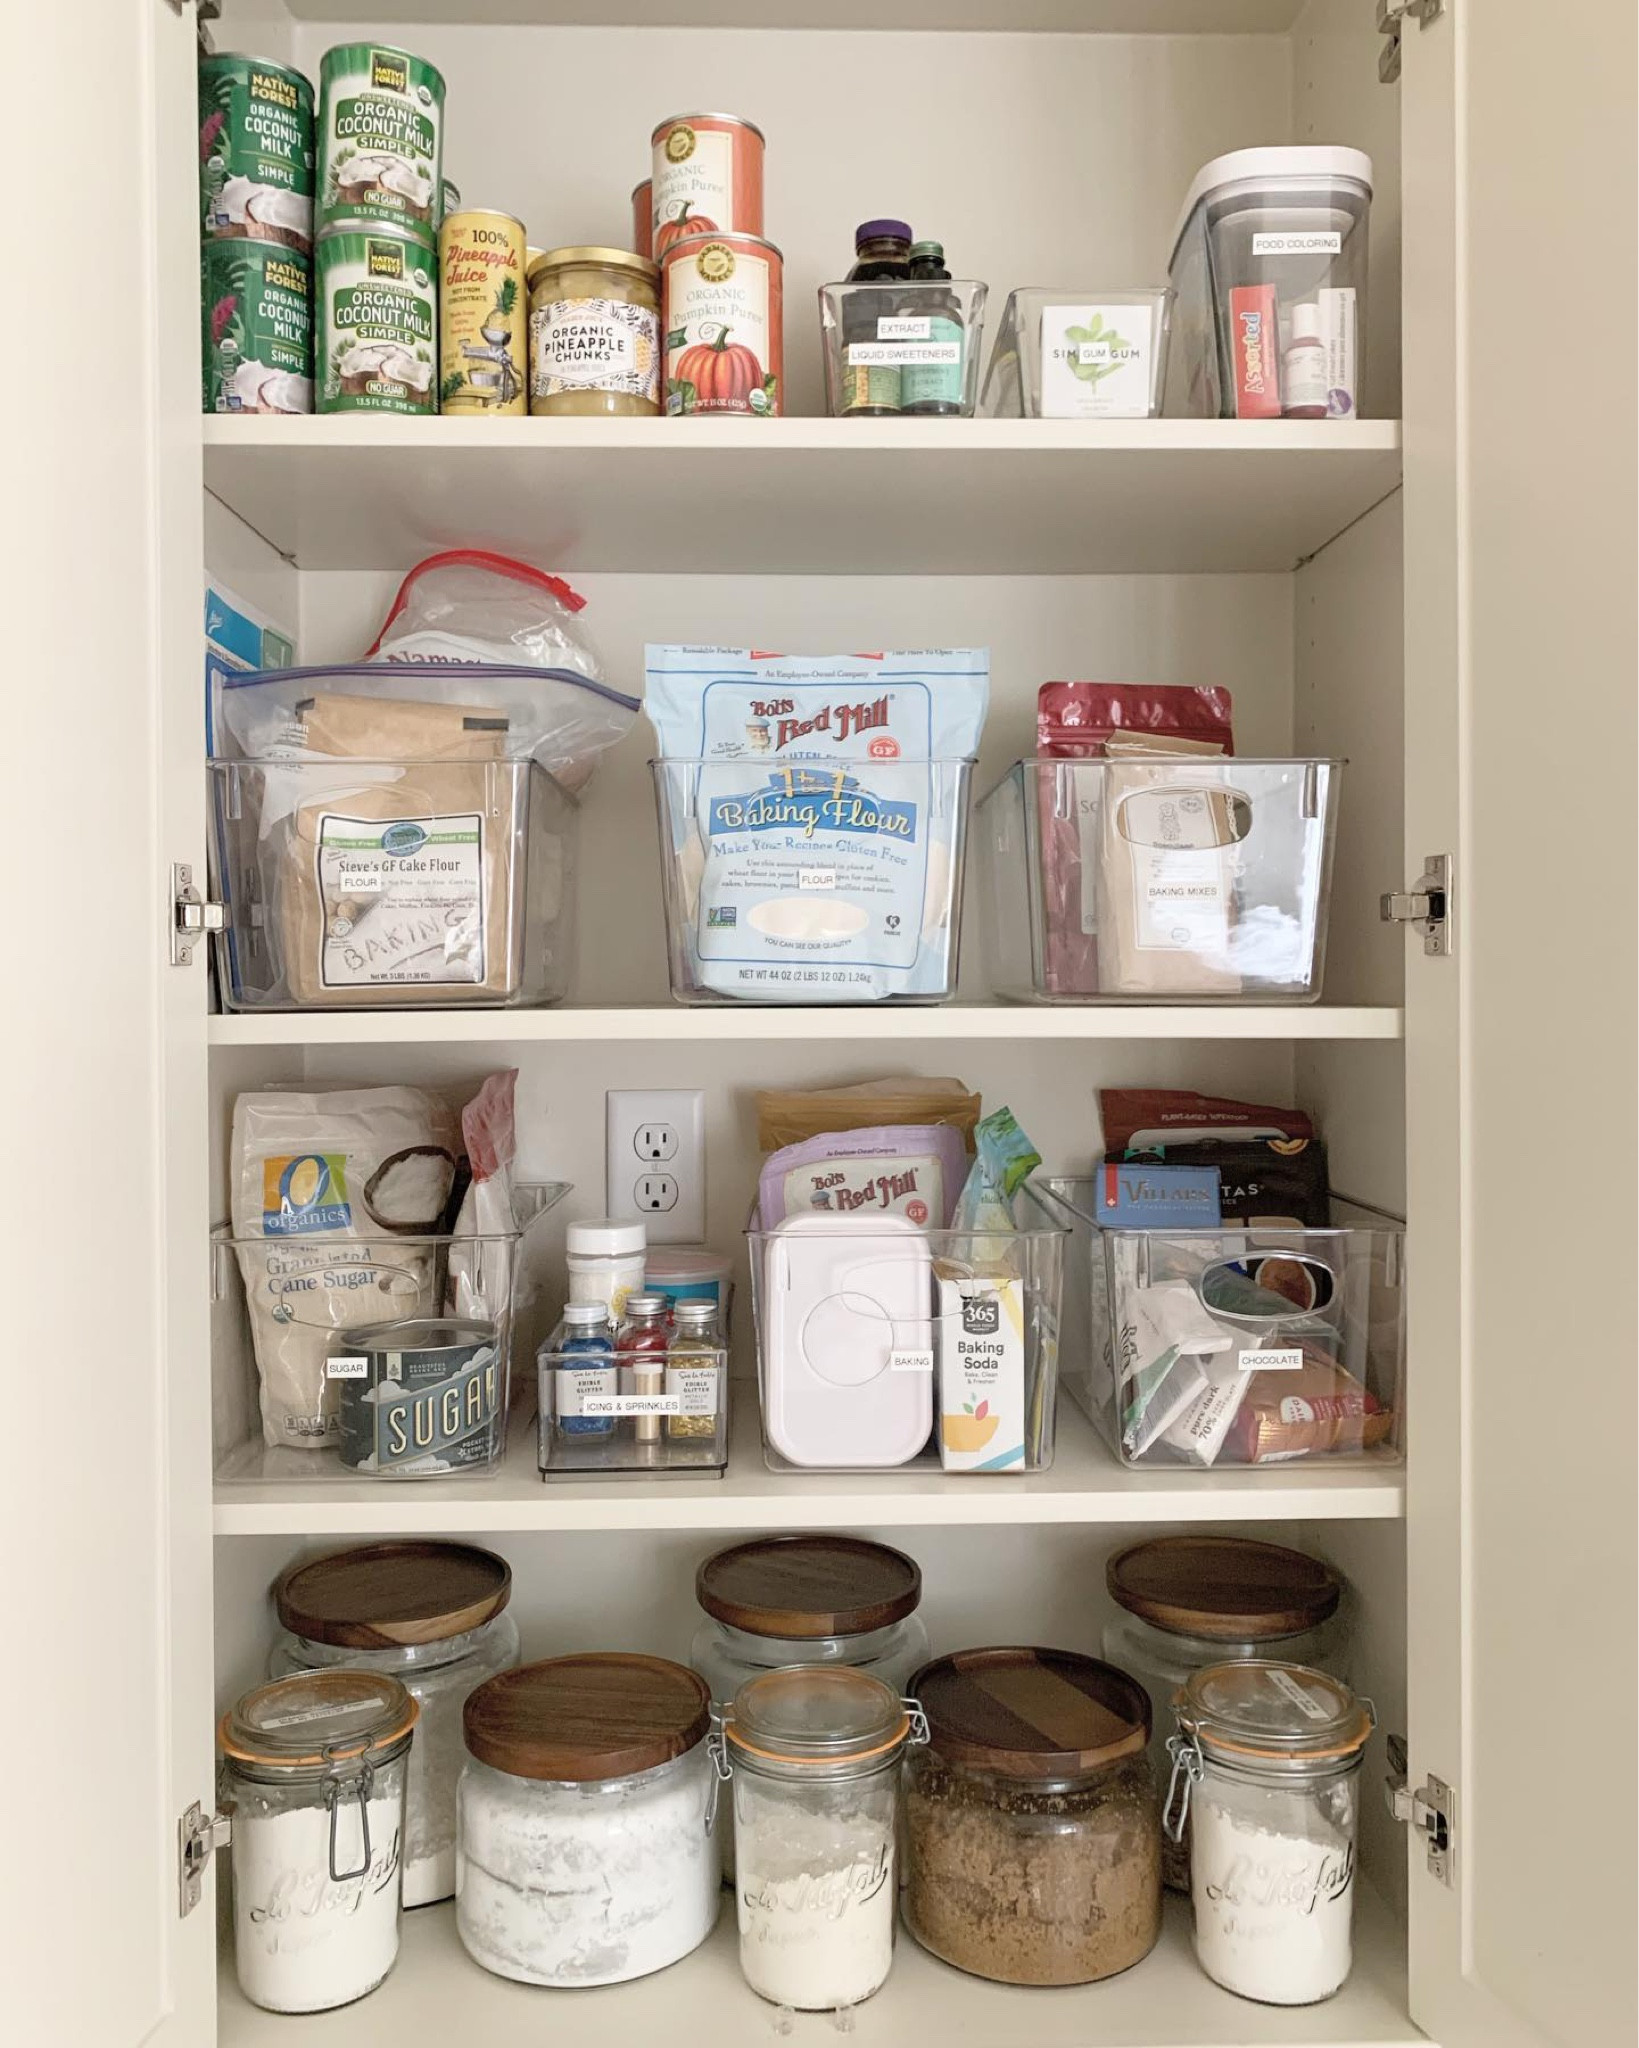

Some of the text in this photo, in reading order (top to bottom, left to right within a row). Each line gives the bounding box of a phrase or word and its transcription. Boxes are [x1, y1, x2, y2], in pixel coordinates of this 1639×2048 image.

[375, 66, 404, 80] NATIVE
[375, 74, 406, 88] FOREST
[252, 74, 297, 97] NATIVE
[251, 86, 297, 109] FOREST
[250, 104, 298, 129] ORGANIC
[354, 101, 420, 130] ORGANIC
[244, 117, 302, 148] COCONUT
[337, 117, 433, 157] COCONUT MILK
[261, 136, 292, 159] MILK
[359, 137, 414, 159] SIMPLE
[257, 164, 295, 185] SIMPLE
[368, 192, 380, 202] NO
[369, 208, 378, 217] FL
[379, 209, 389, 218] OZ
[472, 229, 509, 248] 100%
[1256, 238, 1338, 249] FOOD COLORING
[371, 255, 401, 266] NATIVE
[446, 246, 519, 270] Pineapple
[266, 260, 307, 281] NATIVE
[371, 263, 401, 275] FOREST
[446, 264, 488, 286] Juice
[265, 272, 307, 293] FOREST
[465, 287, 481, 295] FROM
[264, 289, 307, 314] ORGANIC
[352, 291, 418, 314] ORGANIC
[686, 288, 746, 302] ORGANIC
[258, 302, 311, 333] COCONUT
[336, 306, 401, 326] COCONUT
[403, 316, 431, 338] MILK
[673, 304, 764, 326] Pumpkin Puree
[274, 321, 302, 343] MILK
[359, 326, 411, 344] SIMPLE
[552, 326, 614, 339] ORGANIC
[881, 324, 926, 333] EXTRACT
[544, 337, 625, 356] PINEAPPLE
[852, 349, 956, 360] LIQUID SWEETENERS
[1053, 349, 1141, 360] SIM GUM
[1083, 348, 1107, 360] GUM
[1240, 311, 1264, 393] Assorted
[271, 350, 305, 369] SIMPLE
[555, 351, 611, 364] CHUNKS
[369, 383, 405, 397] NO GUAR
[373, 398, 379, 407] FL
[380, 399, 391, 408] OZ
[764, 669, 774, 678] An
[838, 669, 869, 679] Company
[750, 694, 890, 751] Bob's Red Mill
[873, 745, 895, 755] GF
[716, 798, 911, 837] Baking Flour
[713, 843, 748, 857] Make
[836, 839, 878, 858] Gluten
[881, 847, 908, 866] Free
[339, 858, 460, 873] Steve's GF Cake Flour
[344, 879, 378, 887] FLOUR
[802, 875, 833, 884] FLOUR
[1149, 887, 1217, 897] BAKING MIXES
[344, 908, 468, 972] BAKING
[764, 937, 779, 947] YOU
[780, 940, 794, 949] CAN
[795, 941, 807, 950] SEE
[808, 941, 822, 950] OUR
[739, 969, 754, 980] NET
[756, 970, 767, 980] WT
[769, 970, 780, 980] 44
[781, 970, 792, 980] OZ
[793, 970, 802, 981] (2
[803, 970, 819, 981] LBS
[821, 971, 831, 981] 12
[832, 971, 846, 982] OZ)
[811, 1168, 918, 1211] Bob's Red Mill
[268, 1209, 347, 1231] organics
[908, 1206, 925, 1217] GF
[268, 1270, 378, 1295] Cane Sugar
[966, 1305, 995, 1323] 365
[958, 1341, 1005, 1356] Baking
[329, 1364, 364, 1373] SUGAR
[894, 1358, 930, 1366] BAKING
[964, 1357, 999, 1370] Soda
[1242, 1356, 1300, 1365] CHOCOLATE
[388, 1363, 498, 1455] SUGAR
[586, 1402, 613, 1411] ICING
[616, 1402, 622, 1411] &
[625, 1401, 679, 1411] SPRINKLES
[1190, 1386, 1220, 1435] pure dark
[1198, 1416, 1217, 1439] 70%
